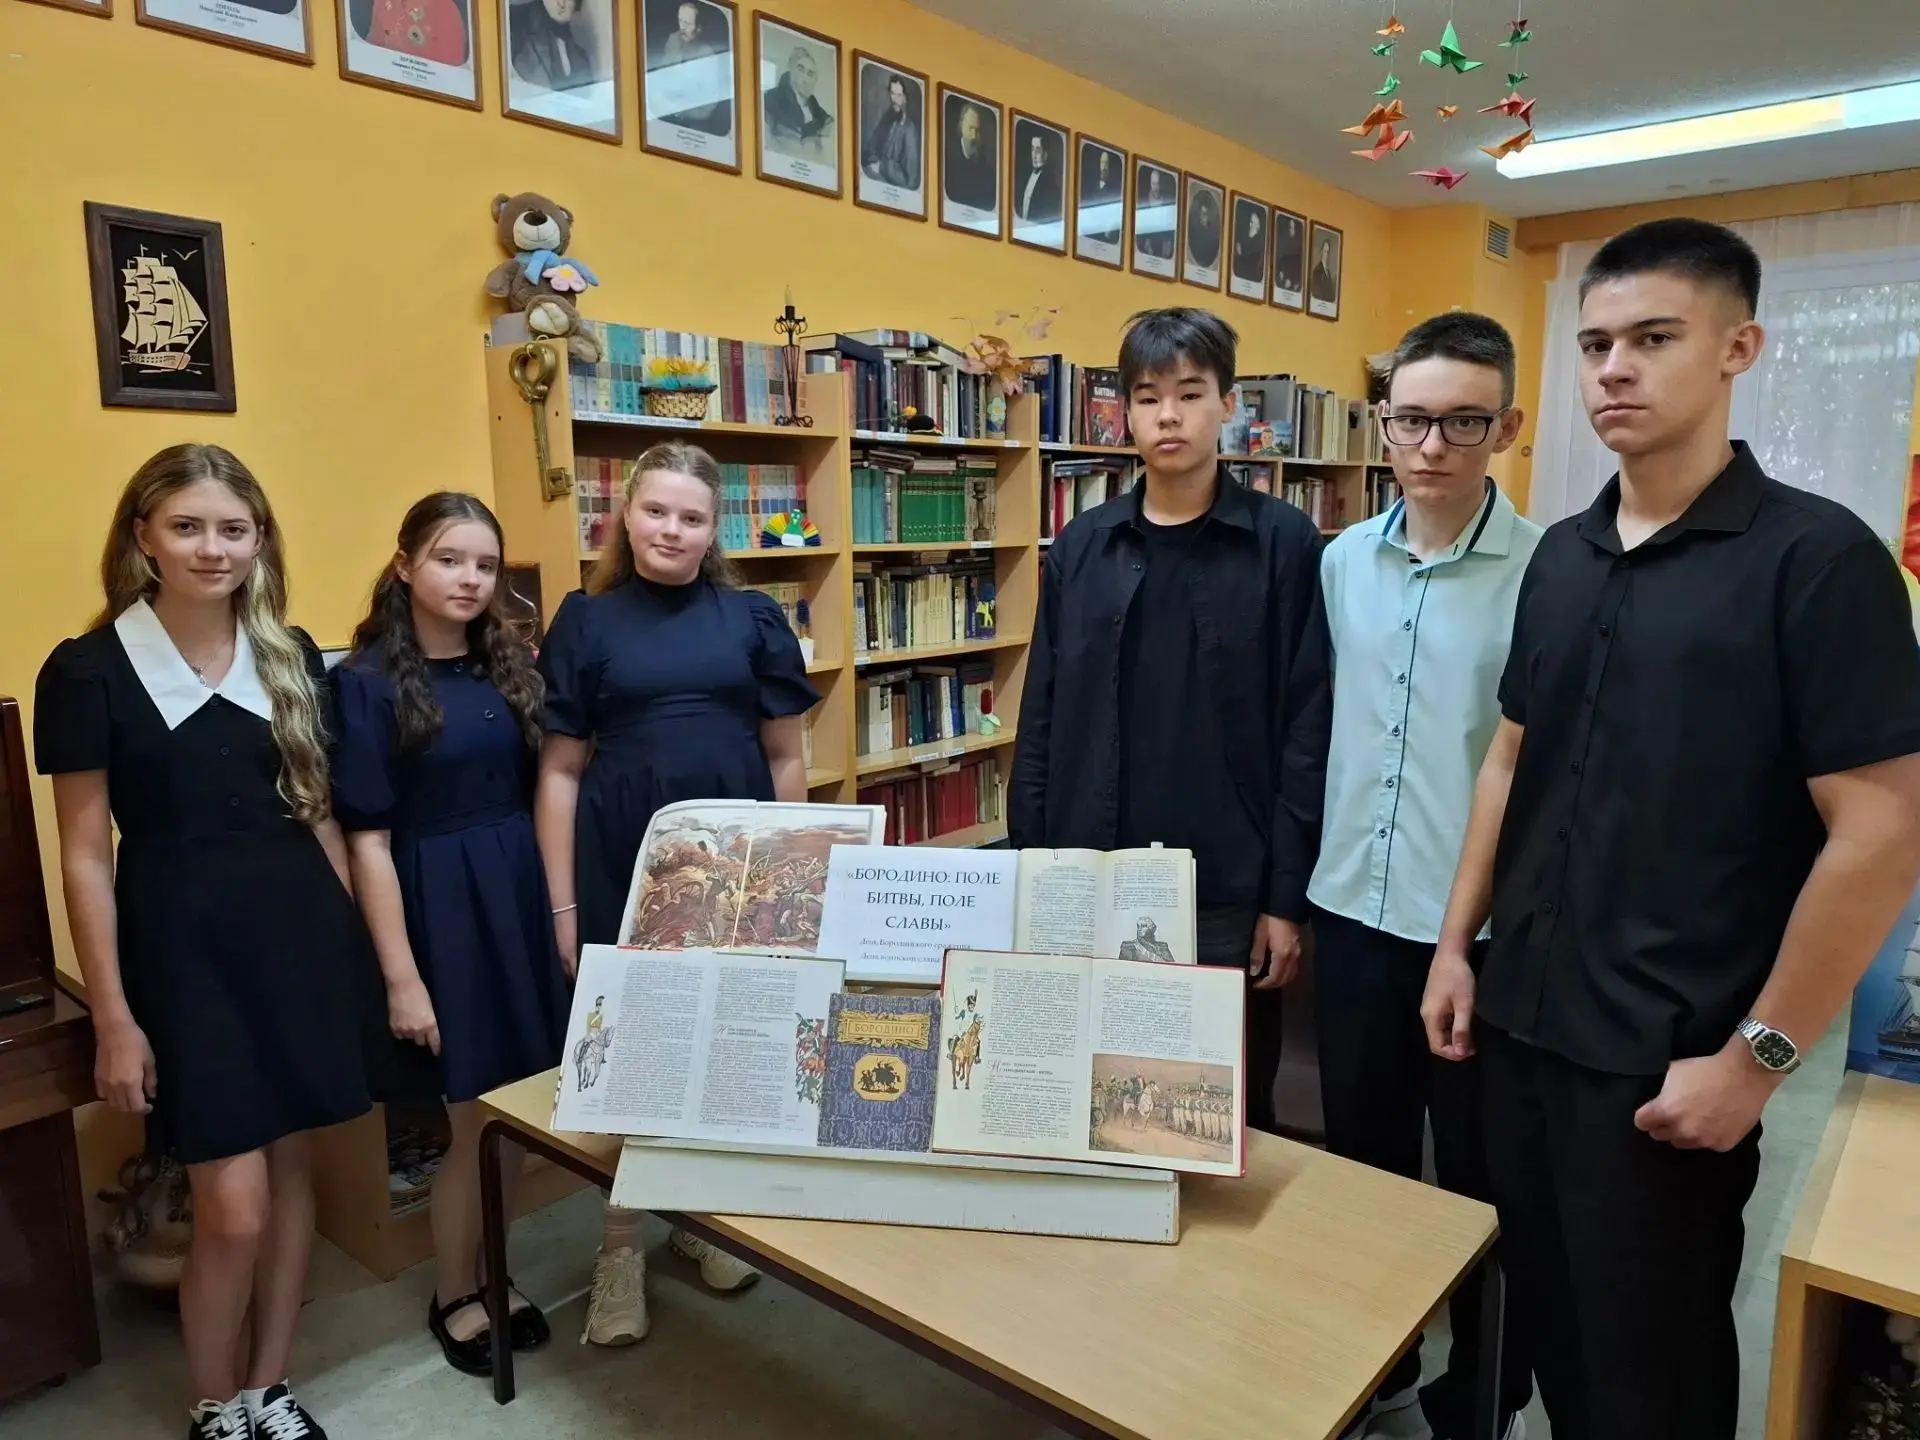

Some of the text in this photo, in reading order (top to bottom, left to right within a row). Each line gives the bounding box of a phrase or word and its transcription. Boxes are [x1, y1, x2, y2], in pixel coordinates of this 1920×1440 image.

[847, 867, 1001, 885] «БОРОДИНО: ПОЛЕ
[866, 891, 976, 908] БИТВЫ, ПОЛЕ
[885, 915, 951, 931] СЛАВЫ»
[854, 1022, 914, 1035] БОРОДИНО
